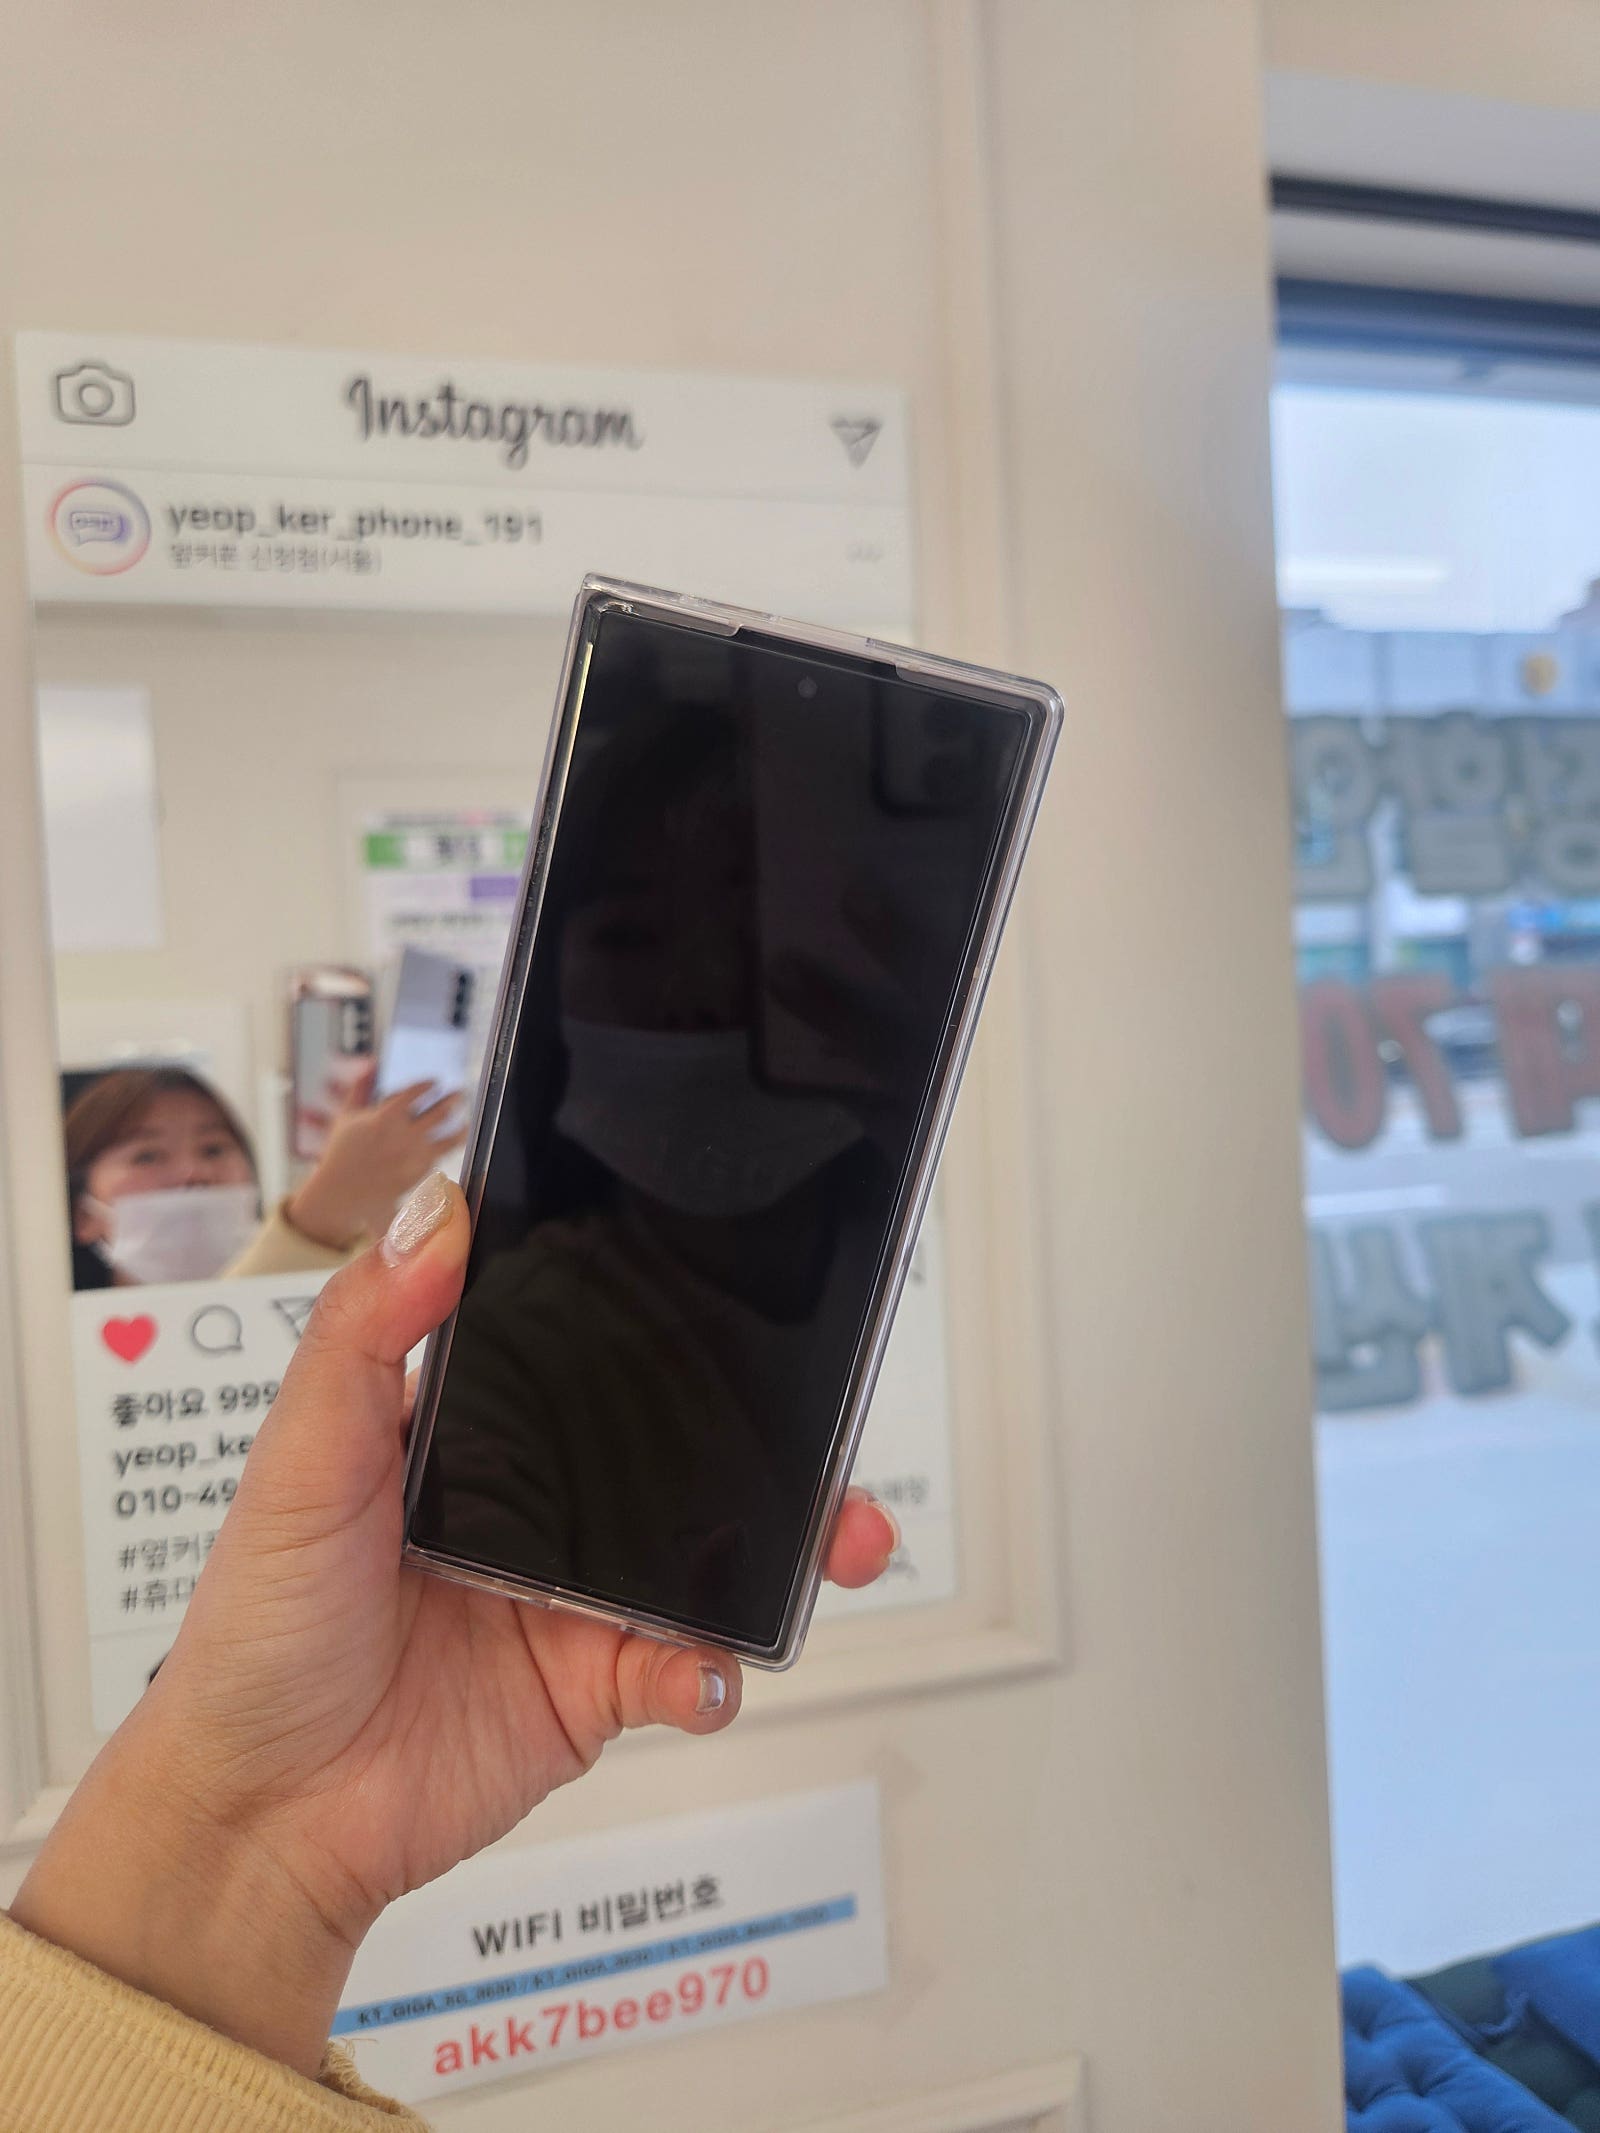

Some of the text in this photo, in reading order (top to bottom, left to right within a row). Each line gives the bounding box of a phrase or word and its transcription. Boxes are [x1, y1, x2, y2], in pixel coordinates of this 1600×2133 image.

[343, 371, 643, 470] Instagram
[166, 502, 543, 545] yeop_ker_phone_191
[113, 1387, 207, 1427] 좋아요
[472, 1907, 564, 1959] WIFI
[579, 1874, 724, 1933] 비밀번호
[433, 1957, 771, 2075] akk7bee970
